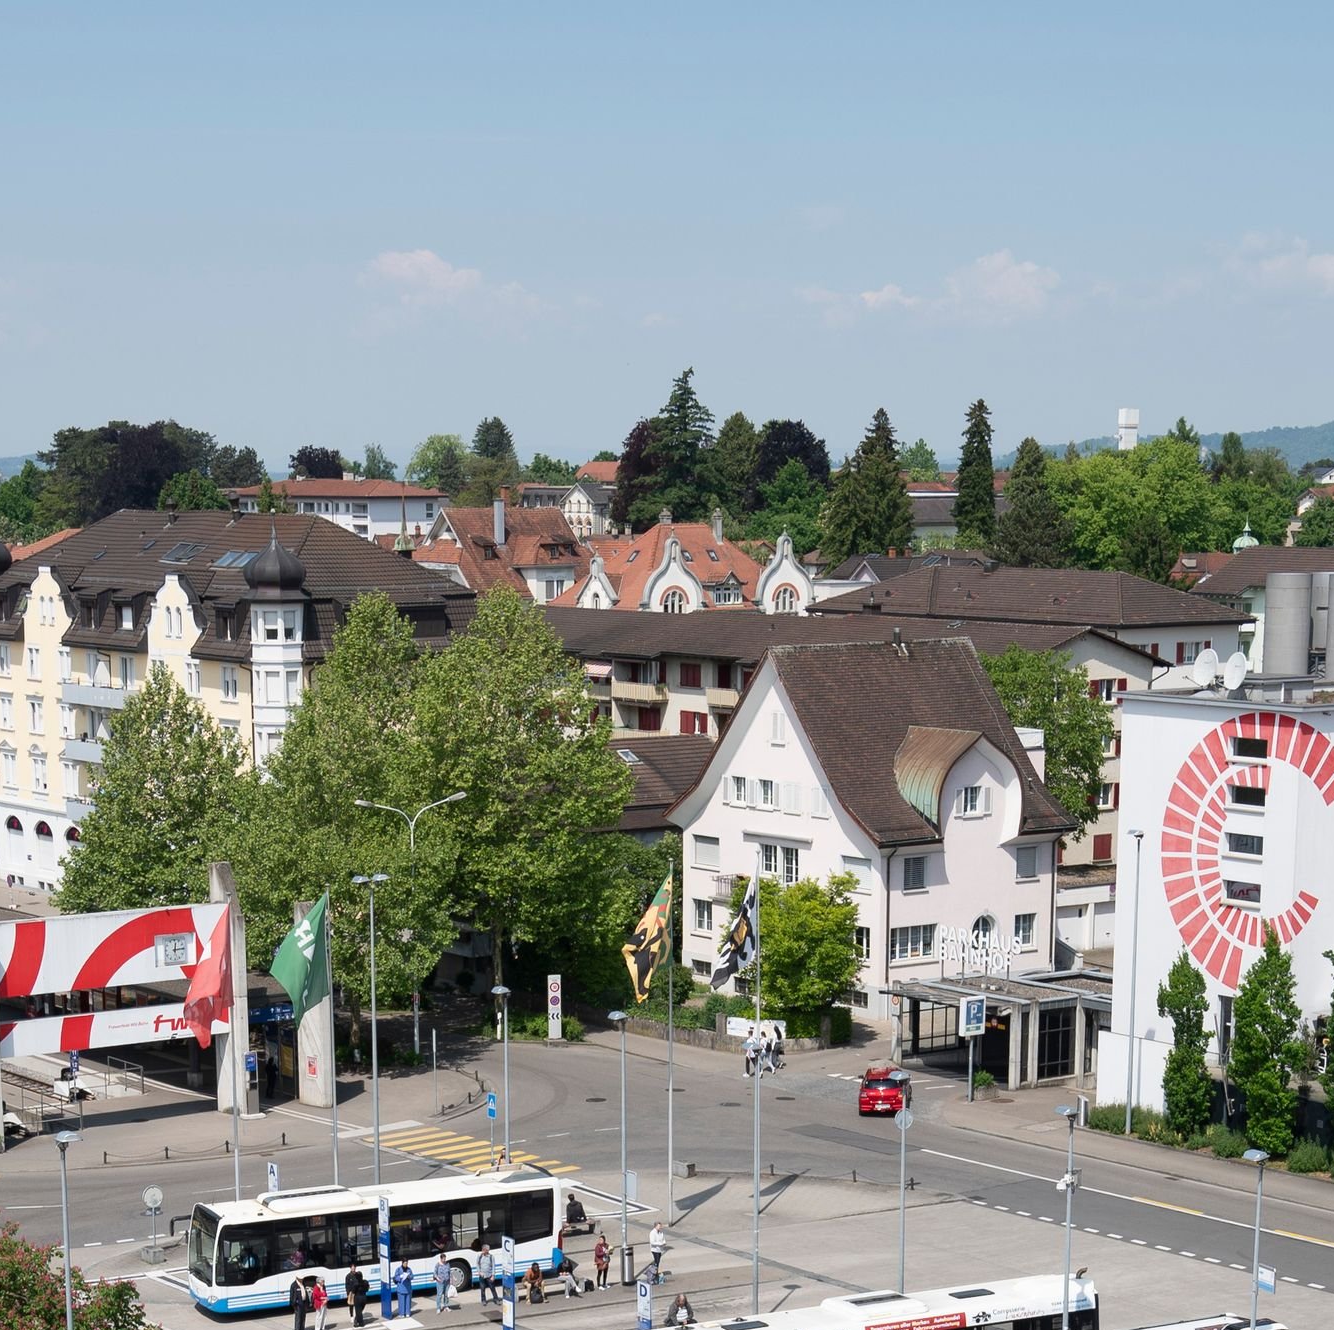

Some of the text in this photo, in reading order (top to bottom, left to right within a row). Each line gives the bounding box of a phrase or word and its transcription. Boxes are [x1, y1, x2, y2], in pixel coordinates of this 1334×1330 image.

[939, 924, 1022, 955] PARKHAUS
[939, 942, 1014, 973] BAHNHOF
[269, 1165, 275, 1176] A
[504, 1240, 510, 1252] C
[639, 1284, 648, 1297] D
